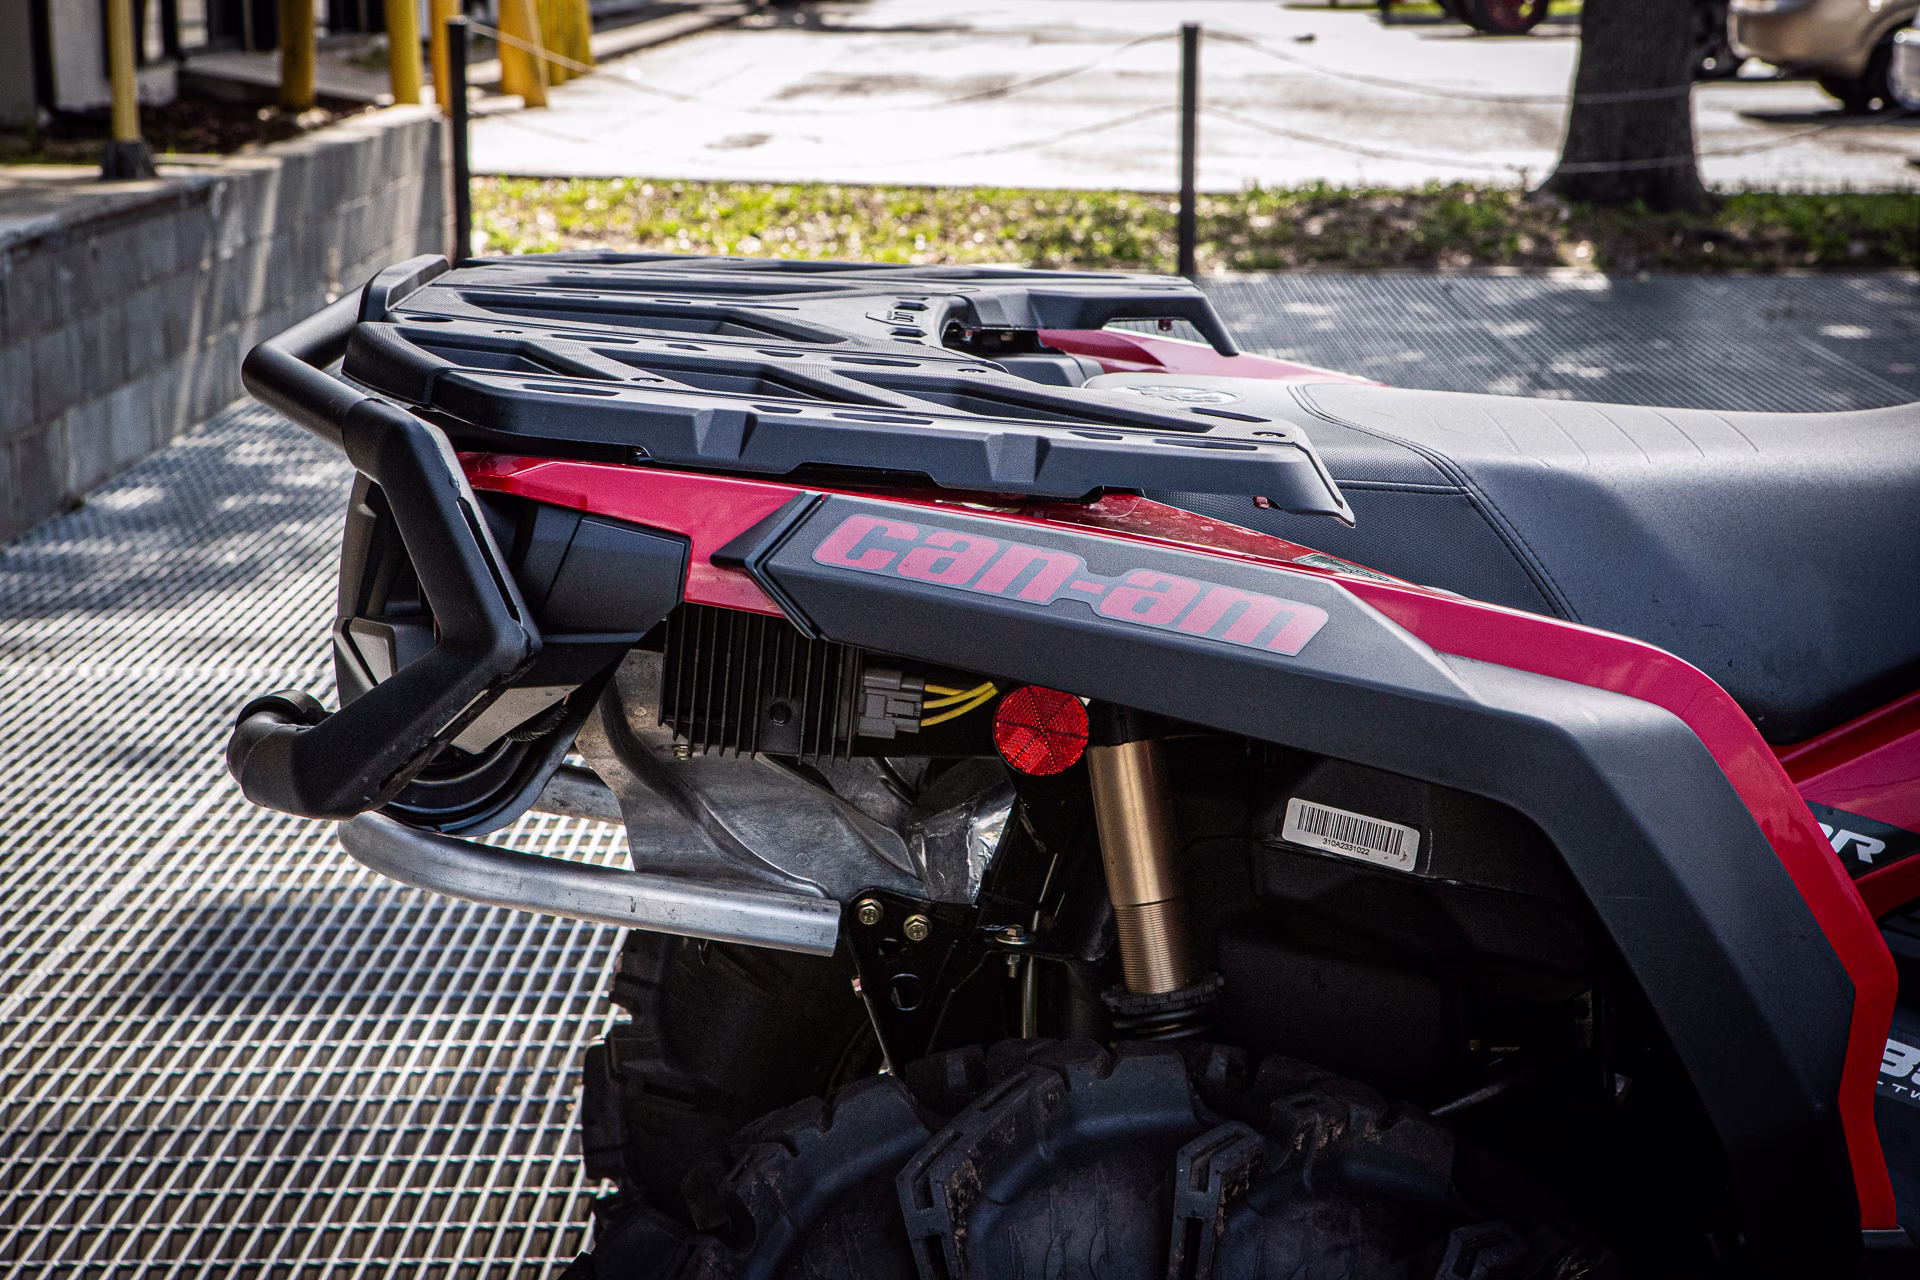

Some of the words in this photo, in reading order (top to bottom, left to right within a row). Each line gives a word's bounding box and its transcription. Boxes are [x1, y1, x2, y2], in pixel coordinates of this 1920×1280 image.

[815, 513, 1328, 655] can-am
[1322, 837, 1370, 856] 310A2331022
[1818, 822, 1886, 864] R
